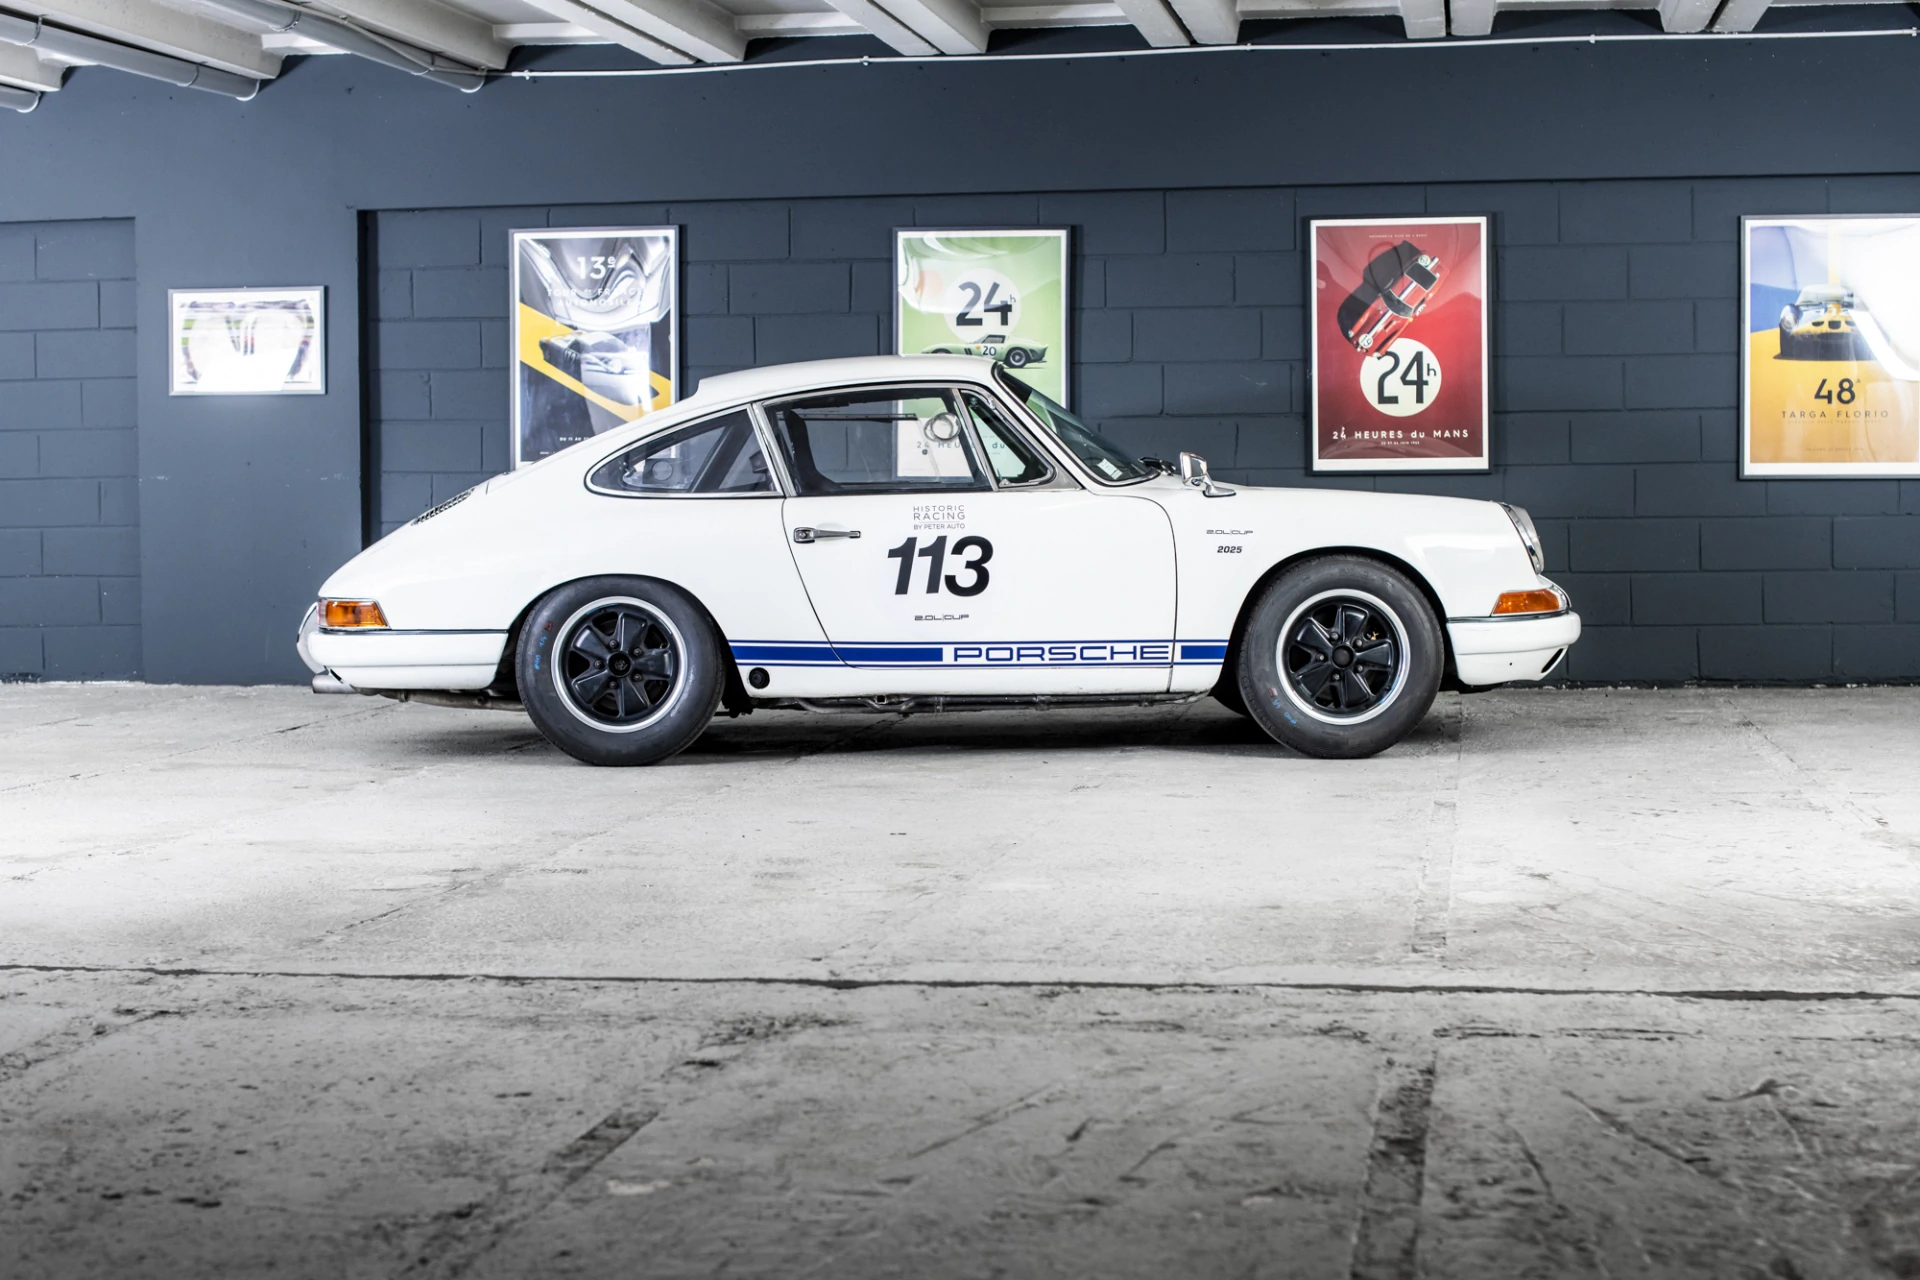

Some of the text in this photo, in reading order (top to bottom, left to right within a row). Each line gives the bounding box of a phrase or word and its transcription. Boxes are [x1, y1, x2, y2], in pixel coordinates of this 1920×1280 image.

[982, 345, 997, 357] 20
[1376, 350, 1437, 404] 24h
[1781, 410, 1889, 418] TARGA FLORIO
[1332, 429, 1469, 440] 24 HEURES du MANS
[916, 441, 930, 449] 24
[913, 504, 965, 512] HISTORIC
[913, 512, 966, 521] RACING
[1216, 545, 1243, 554] 2025
[887, 535, 994, 597] 113
[953, 645, 1170, 662] PORSCHE
